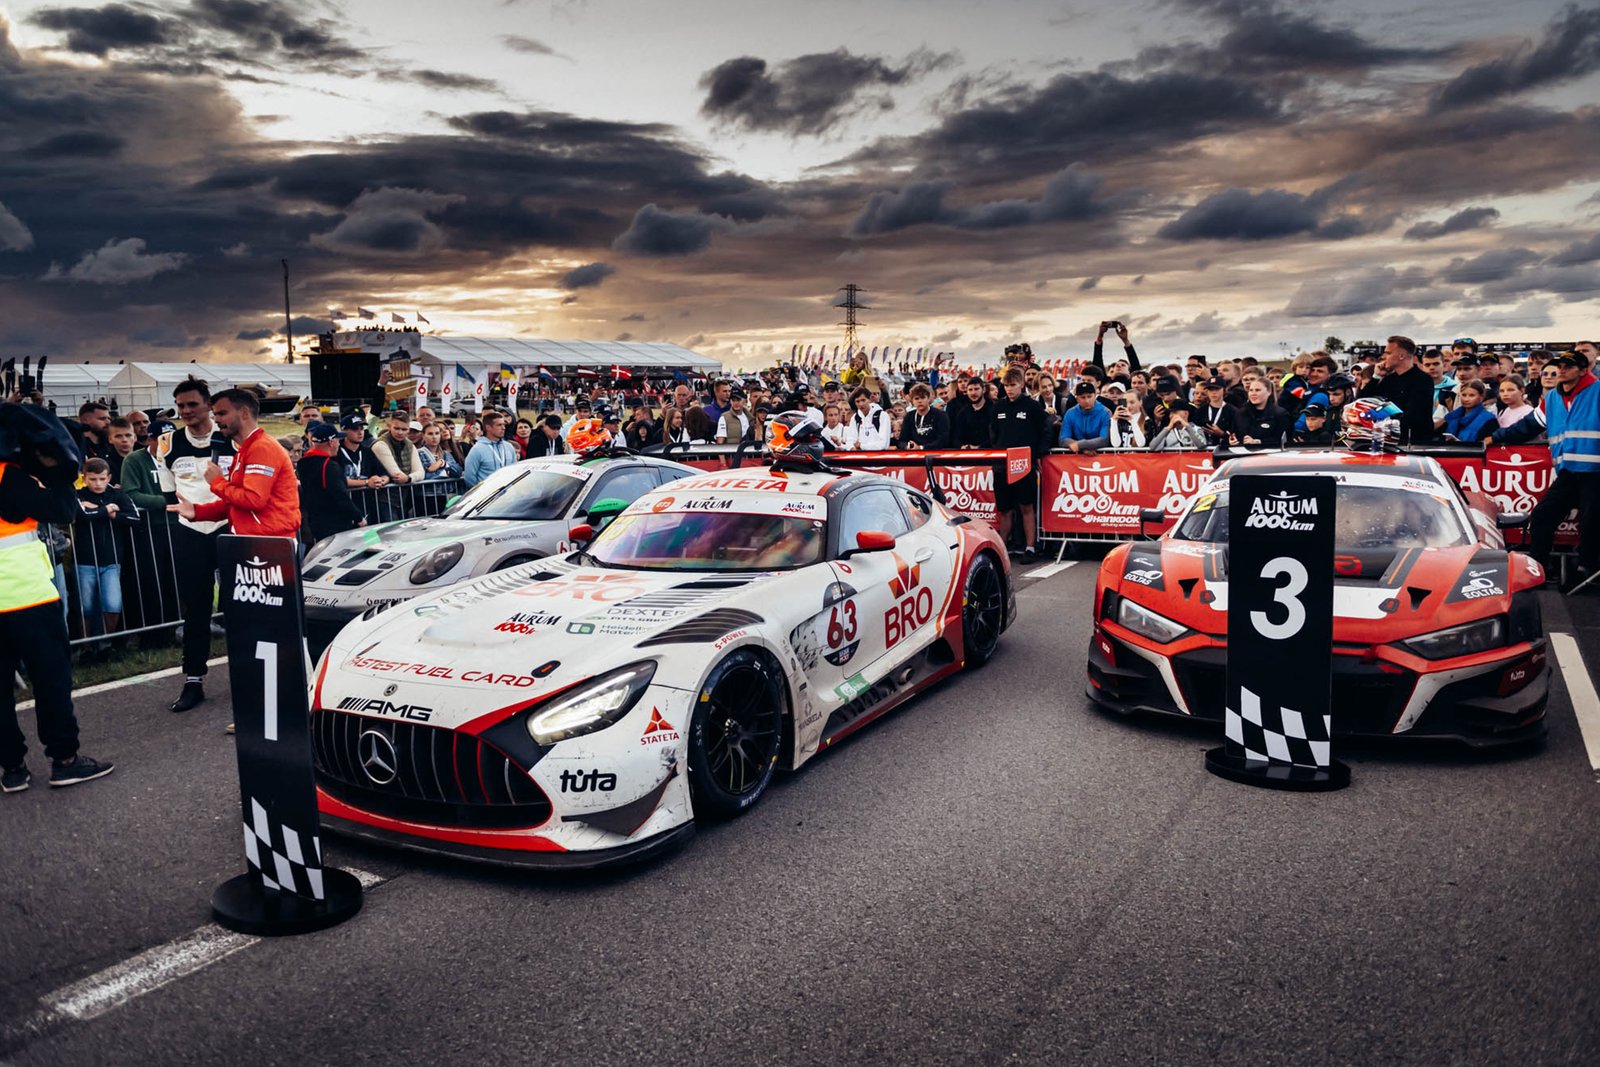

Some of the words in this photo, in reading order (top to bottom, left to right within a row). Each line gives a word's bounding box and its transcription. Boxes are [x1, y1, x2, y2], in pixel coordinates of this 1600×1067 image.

[670, 478, 788, 492] STATETA
[1057, 469, 1139, 493] AURUM
[681, 499, 733, 510] AURUM
[785, 502, 815, 510] AURUM
[1250, 497, 1319, 516] AURUM
[235, 563, 285, 587] AURUM
[1123, 573, 1152, 586] EOLTAS
[1250, 556, 1309, 640] 3
[1463, 587, 1504, 599] EOLTAS
[506, 612, 562, 626] AURUM
[827, 599, 858, 650] 63
[884, 586, 933, 650] BRO
[349, 655, 409, 672] FASTEST
[404, 663, 454, 679] FUEL
[461, 670, 535, 688] CARD
[255, 640, 278, 741] 1
[361, 699, 433, 722] AMG
[640, 732, 680, 746] STATETA
